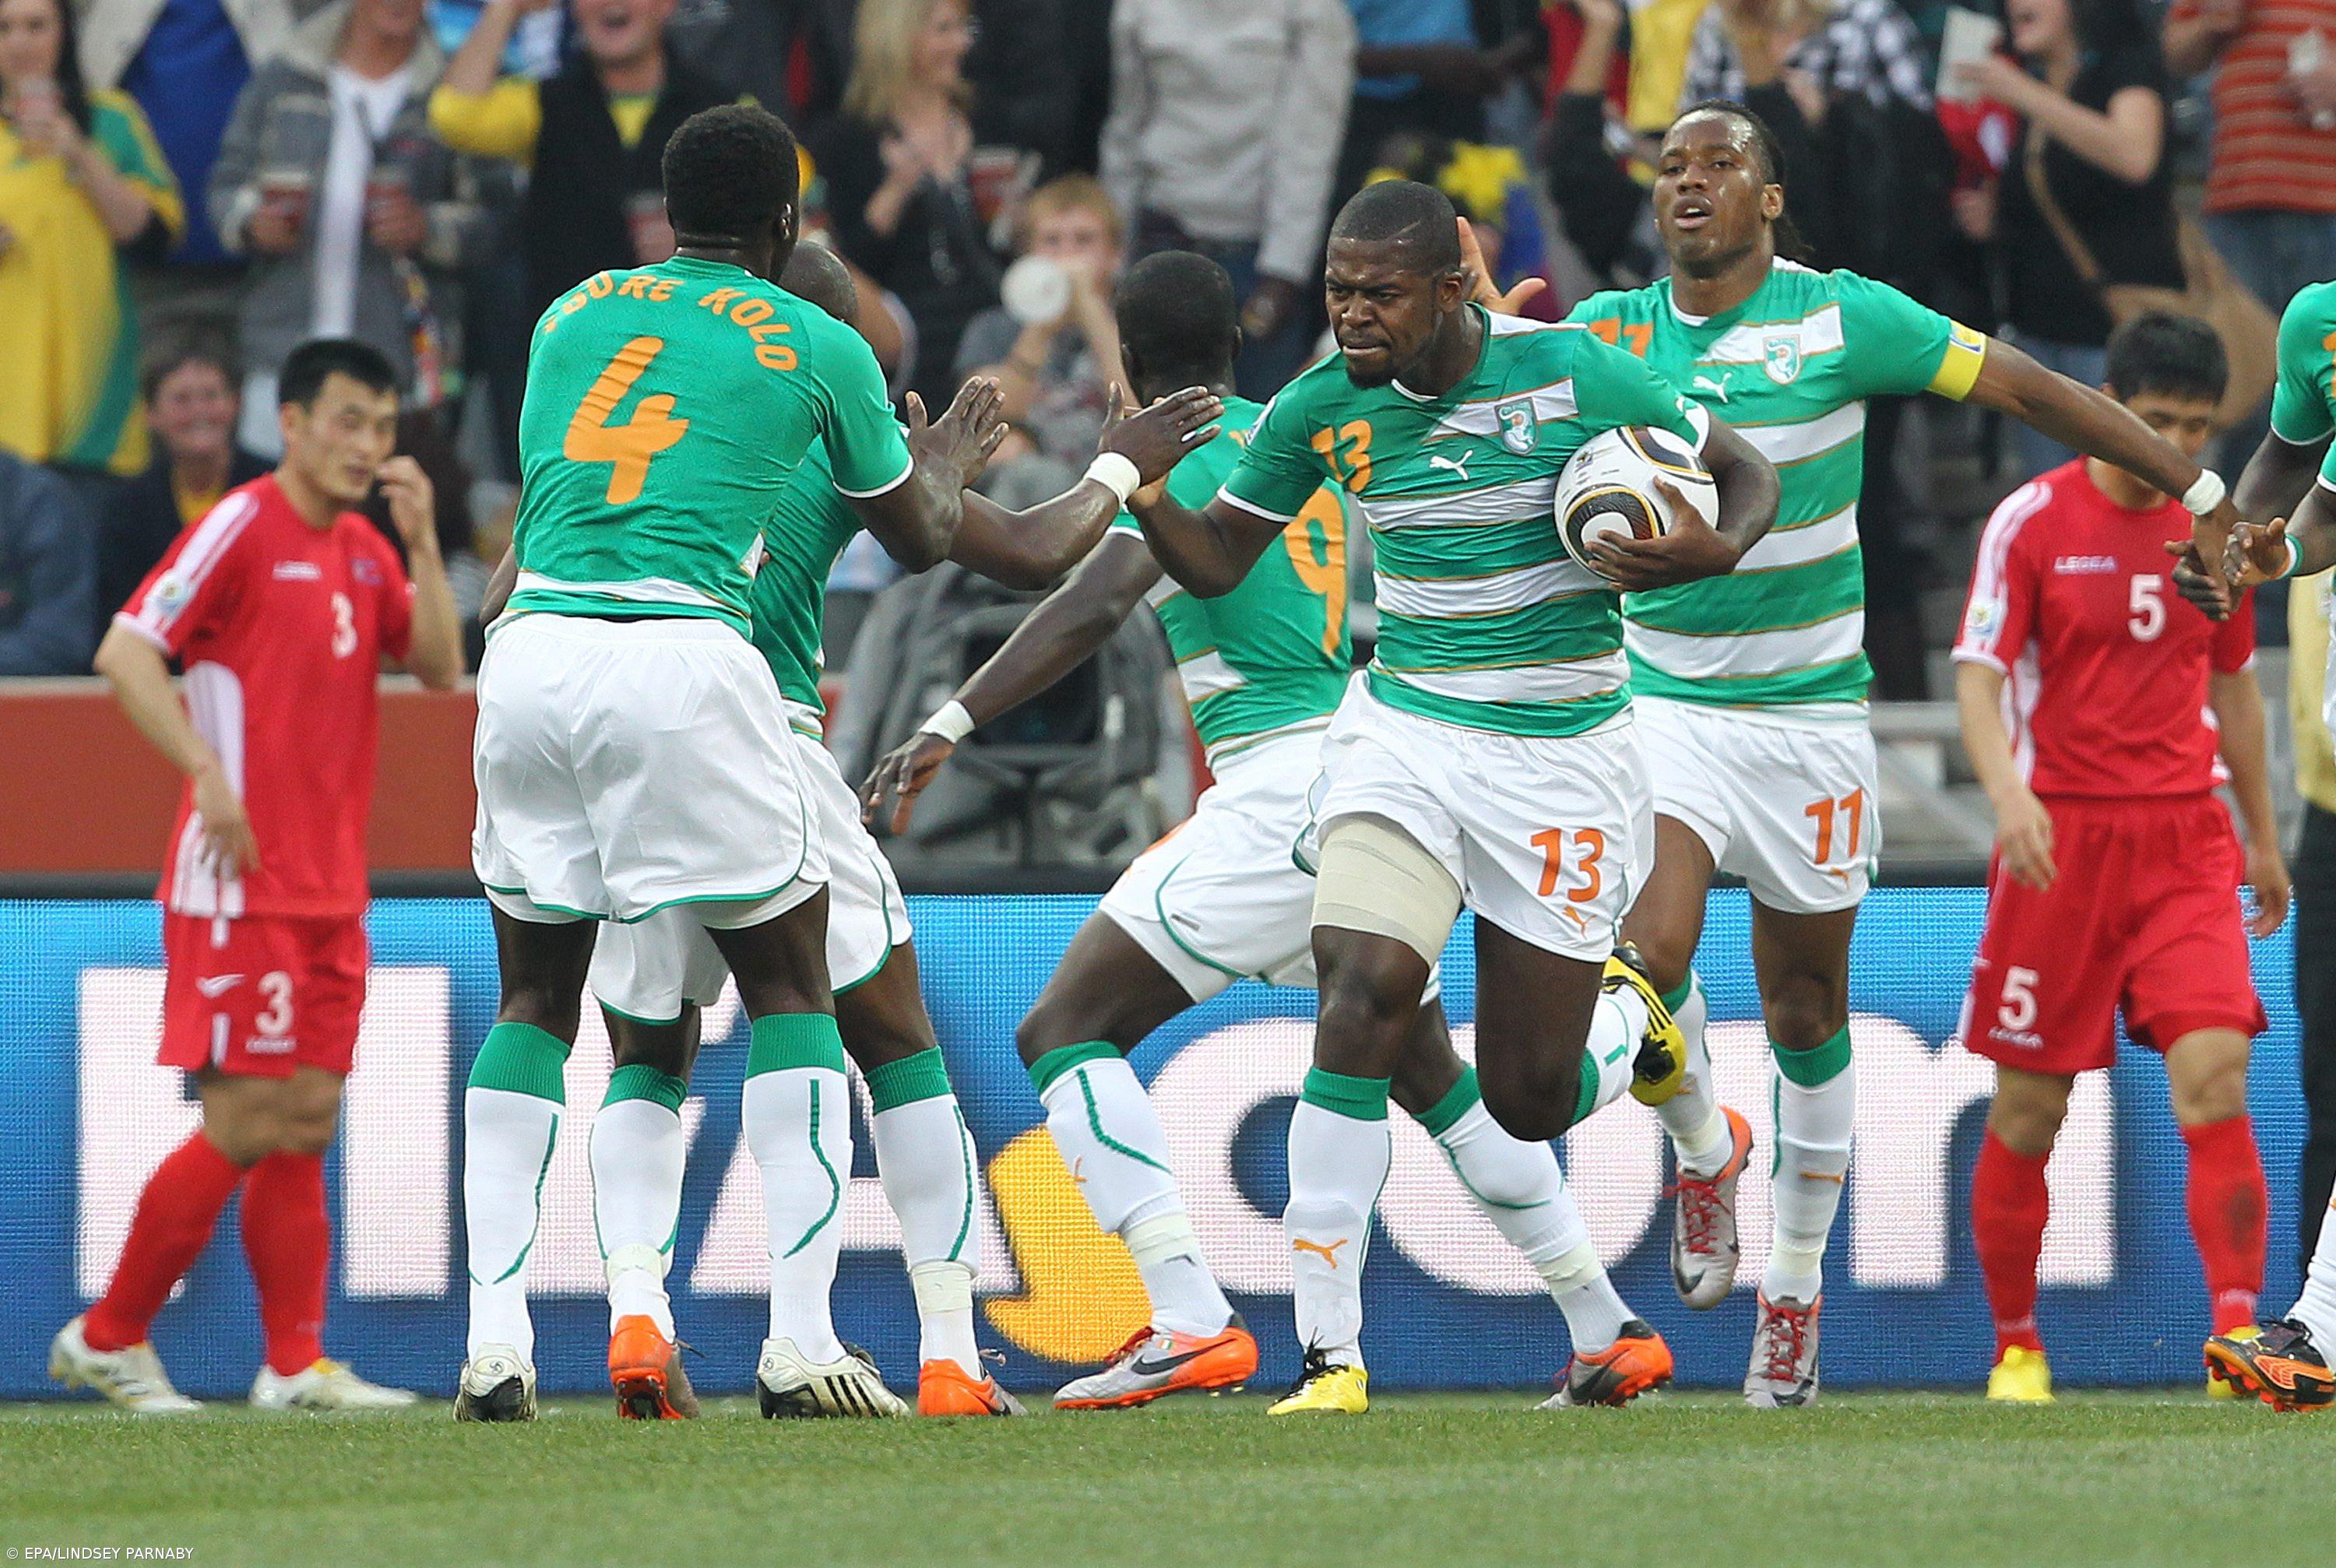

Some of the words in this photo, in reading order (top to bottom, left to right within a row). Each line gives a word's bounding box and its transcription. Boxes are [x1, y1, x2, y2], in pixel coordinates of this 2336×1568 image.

[544, 271, 684, 333] OURE
[698, 287, 798, 371] KOLO
[563, 336, 689, 505] 4
[1310, 419, 1373, 493] 13
[1284, 487, 1348, 658] 9
[2128, 574, 2166, 642] 5
[331, 590, 358, 659] 3
[1805, 787, 1862, 865] 11
[1530, 828, 1603, 902] 13
[255, 970, 294, 1035] 3
[1997, 965, 2039, 1031] 5
